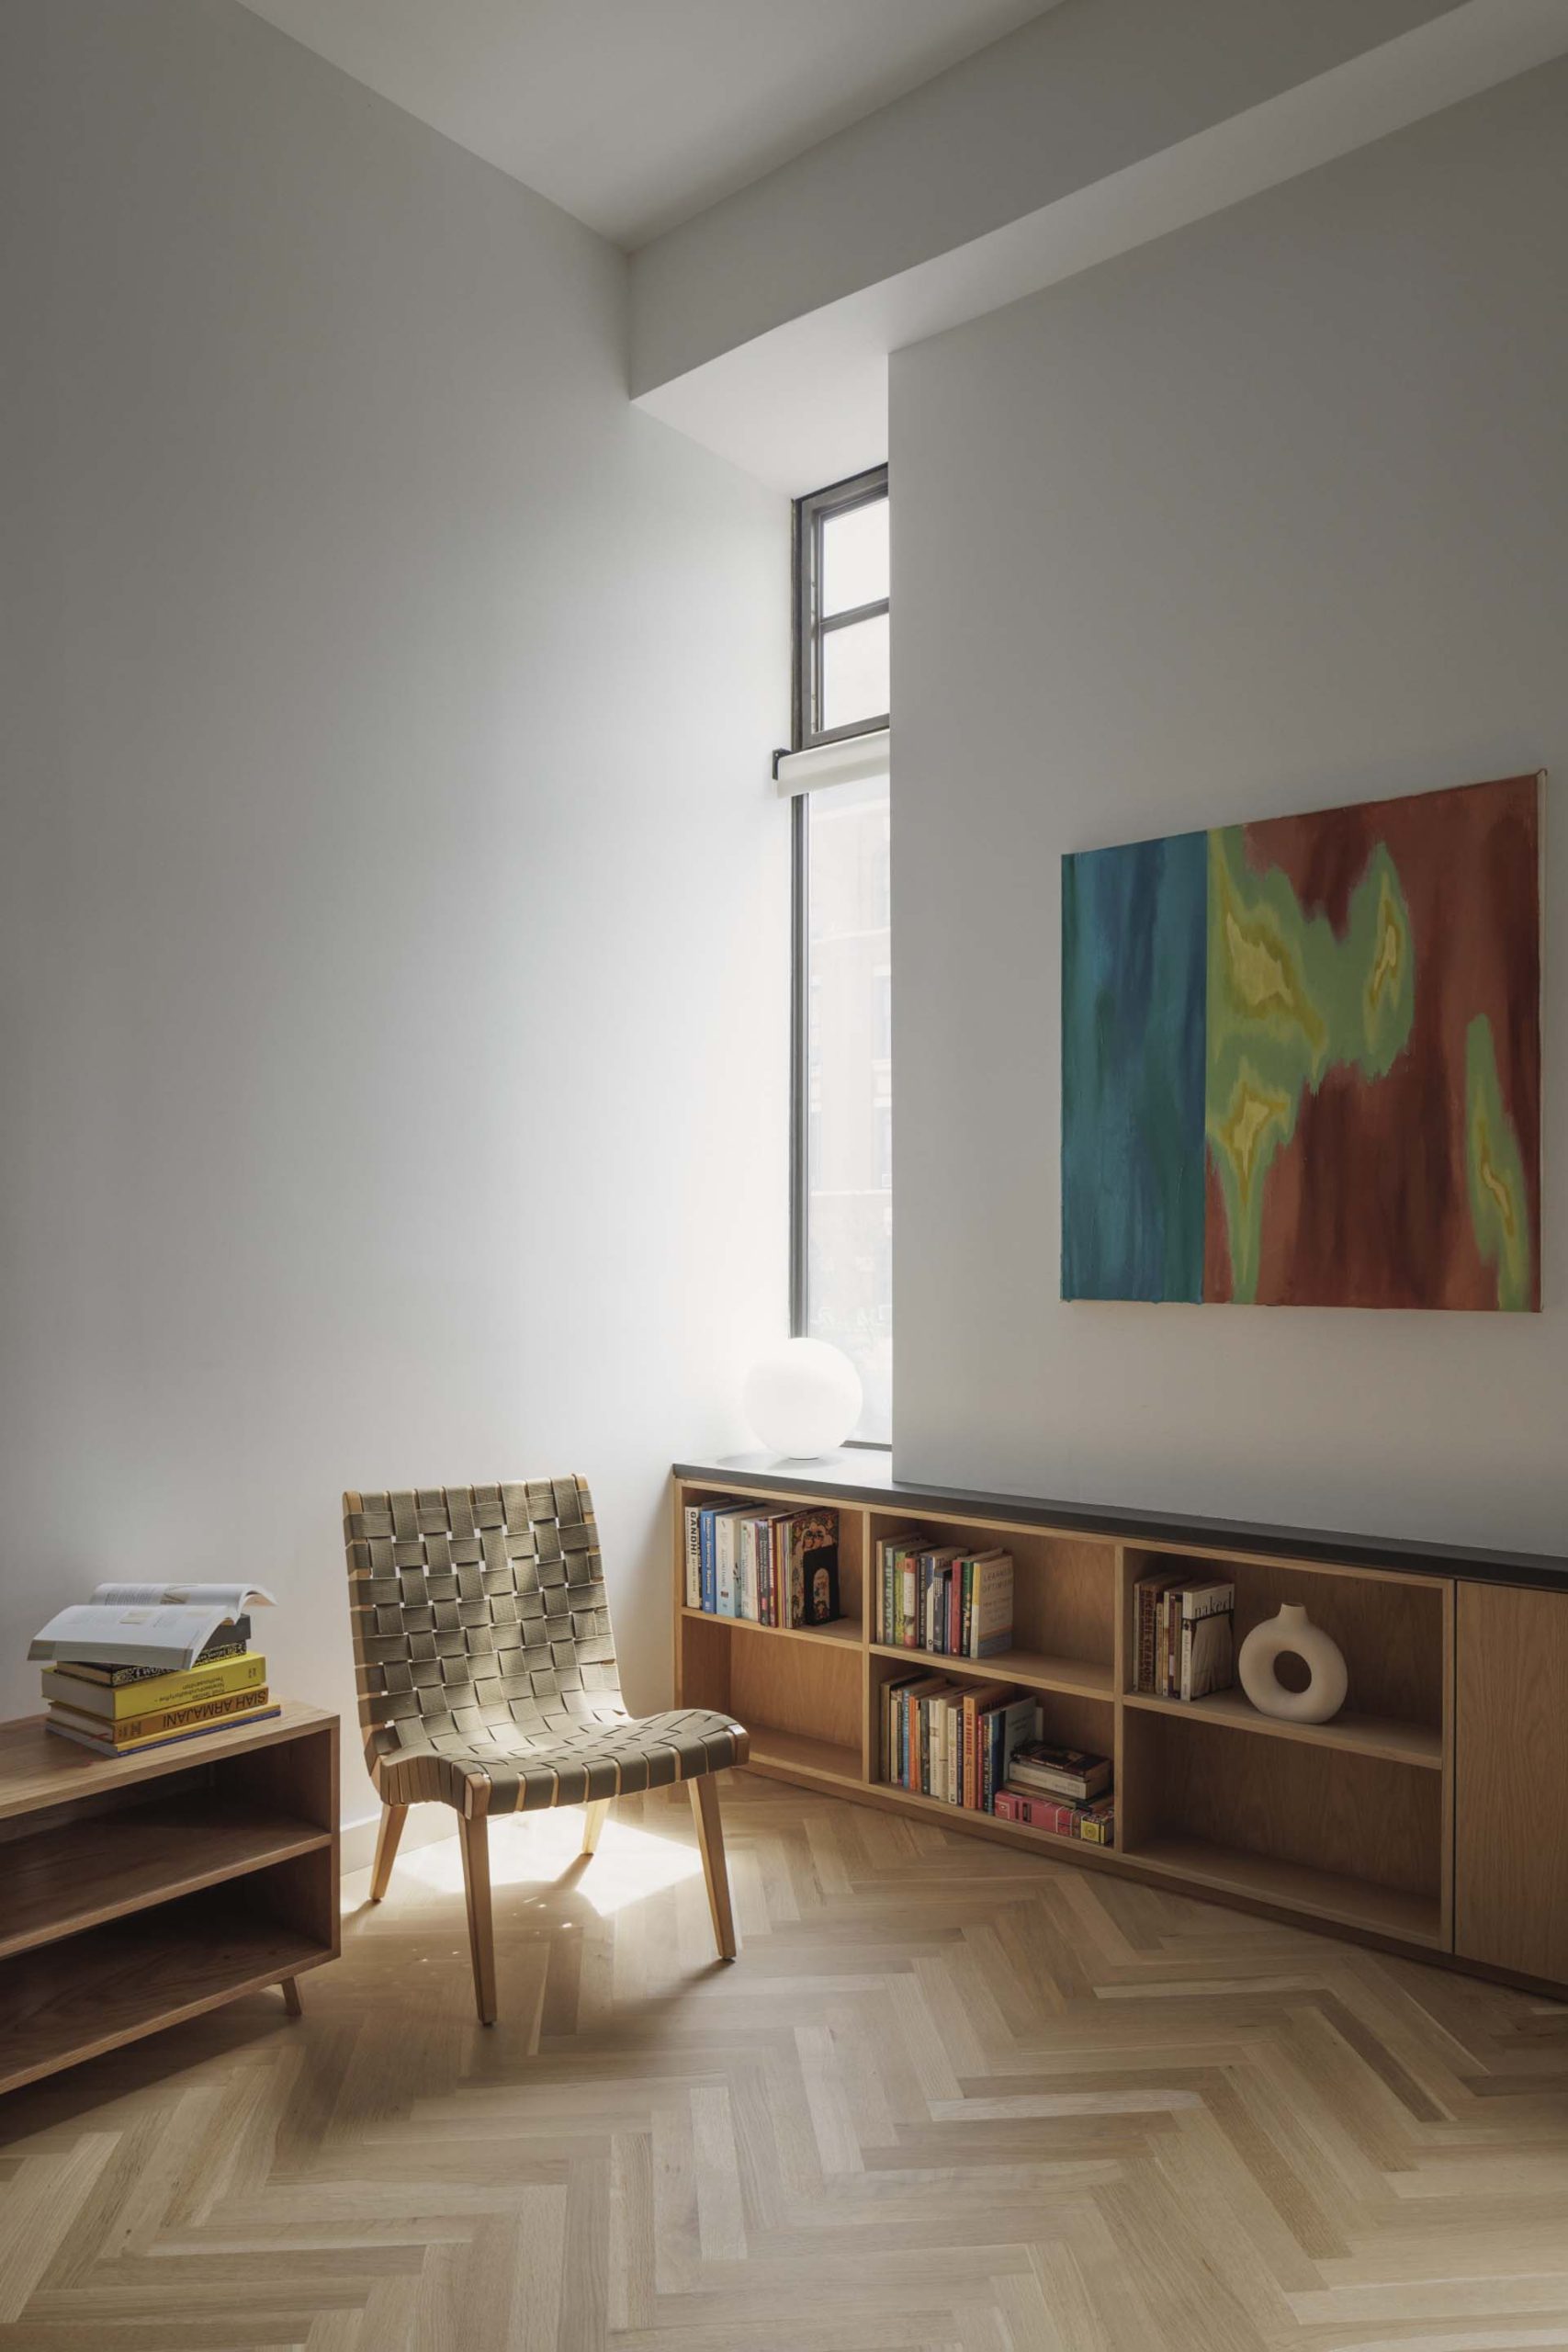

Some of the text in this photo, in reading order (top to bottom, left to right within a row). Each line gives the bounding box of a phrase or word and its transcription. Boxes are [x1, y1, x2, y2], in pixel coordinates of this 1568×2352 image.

[1194, 1591, 1232, 1618] naked
[1143, 1638, 1154, 1683] CHABON
[236, 1690, 266, 1707] SIAH
[163, 1703, 231, 1728] ARMAJANI
